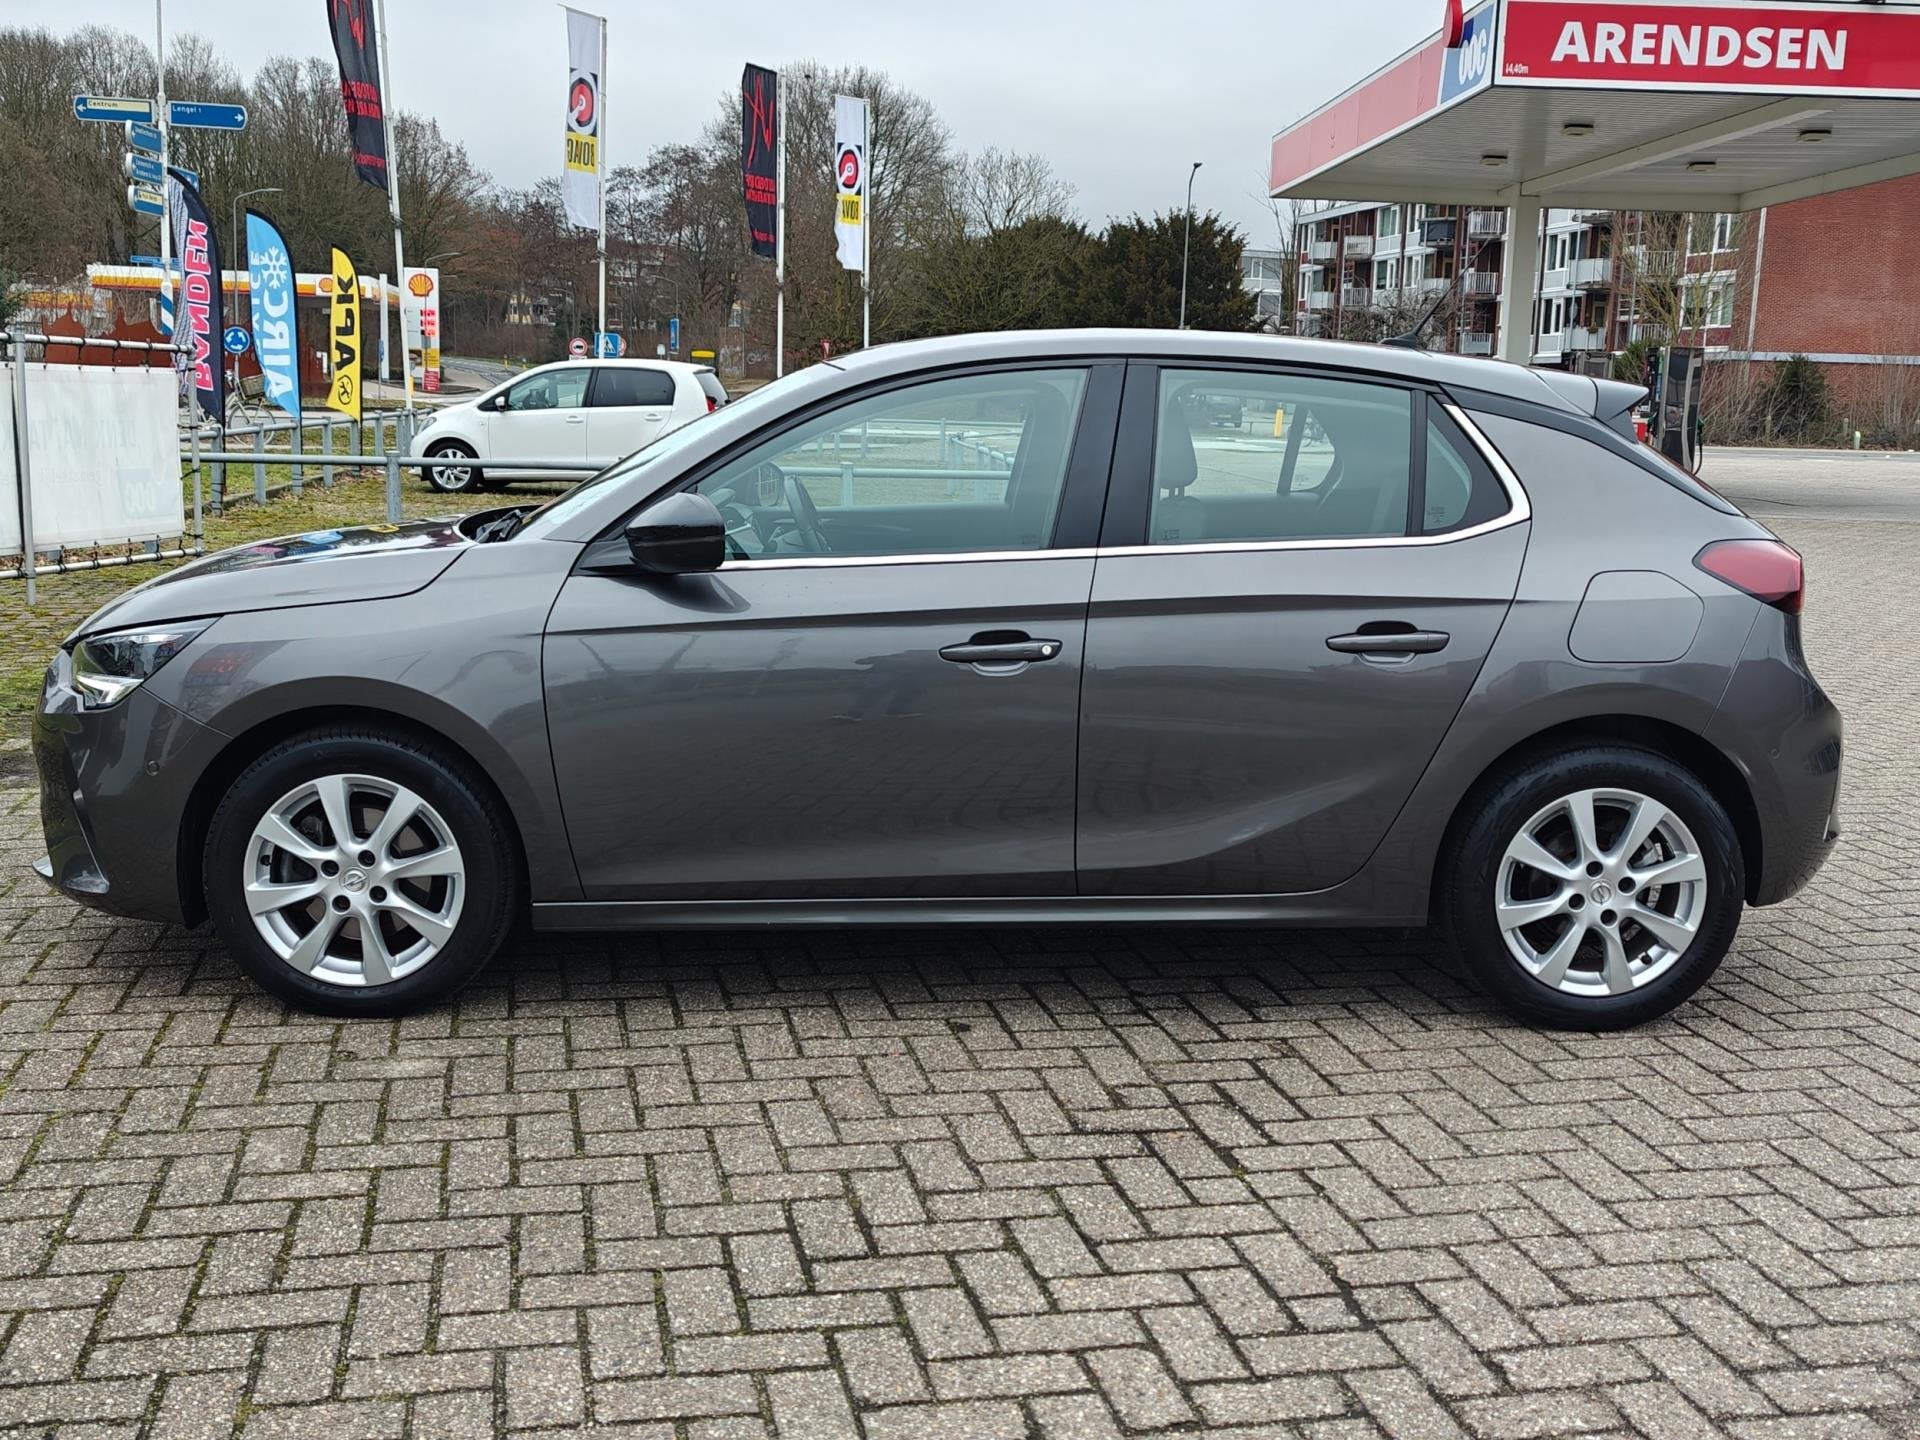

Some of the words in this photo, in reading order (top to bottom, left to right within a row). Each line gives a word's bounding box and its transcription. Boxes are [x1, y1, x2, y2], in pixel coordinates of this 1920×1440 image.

[1550, 21, 1847, 70] ARENDSEN
[88, 99, 118, 108] Centrum
[172, 104, 196, 114] Lengel
